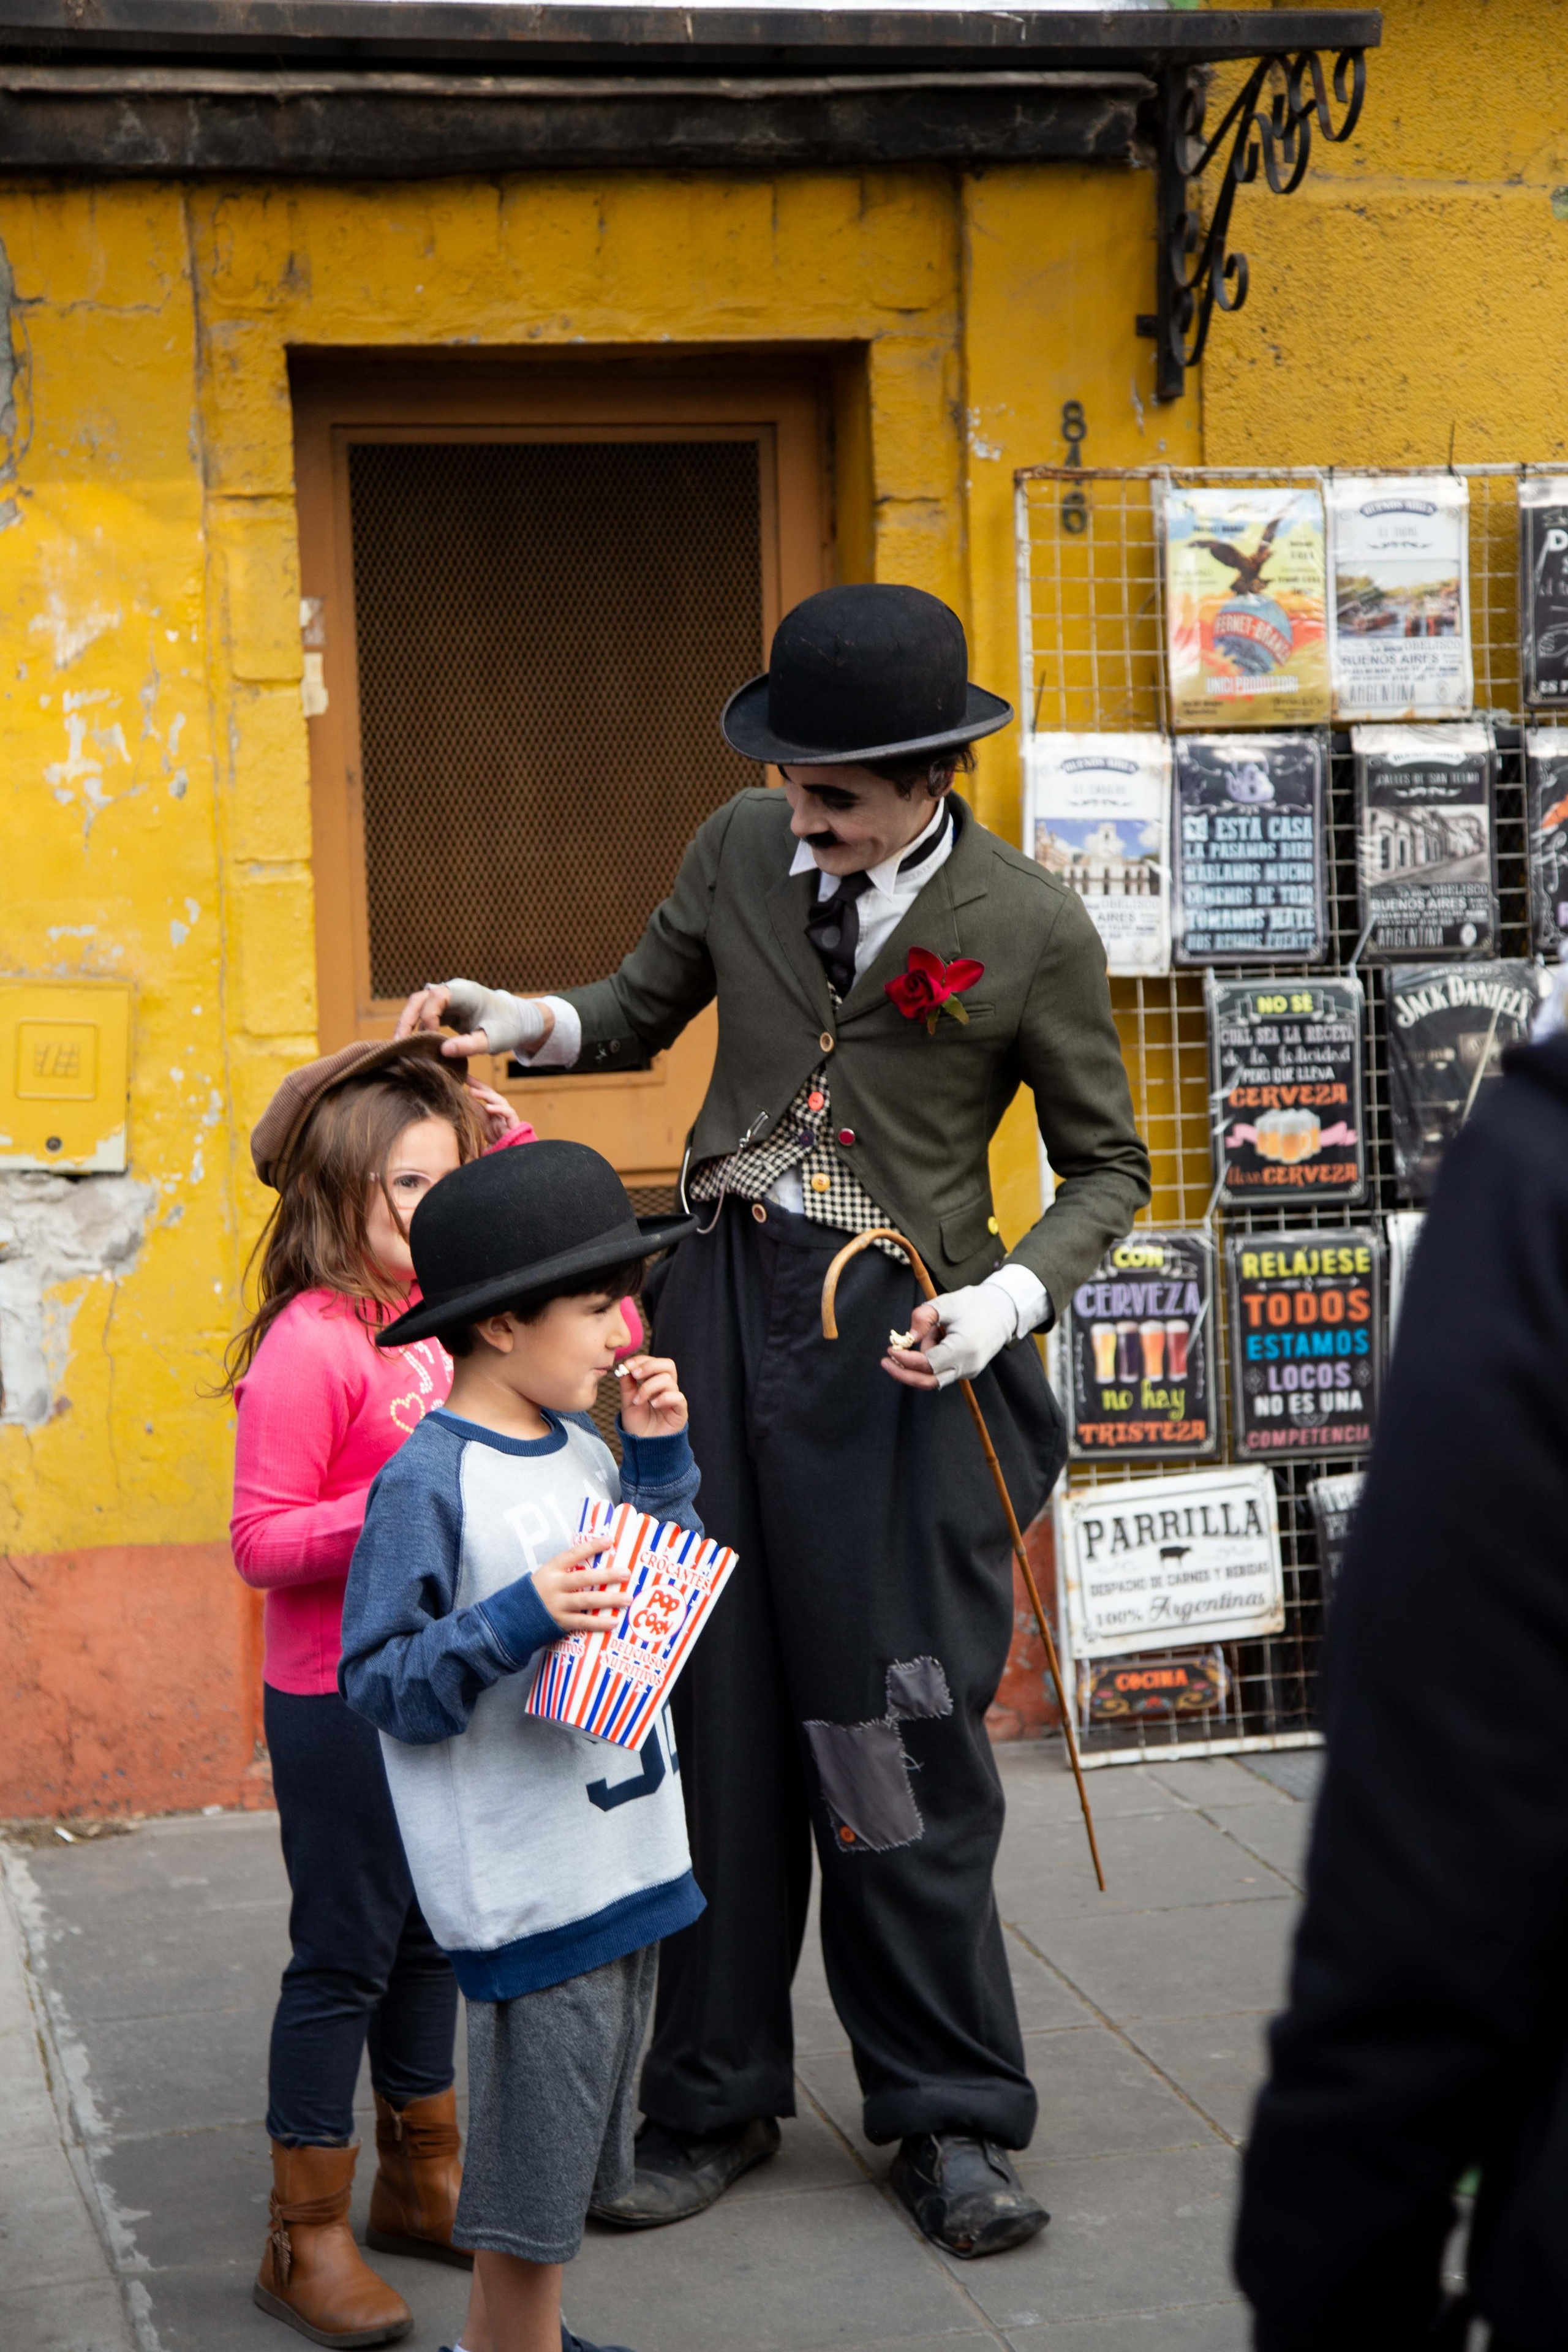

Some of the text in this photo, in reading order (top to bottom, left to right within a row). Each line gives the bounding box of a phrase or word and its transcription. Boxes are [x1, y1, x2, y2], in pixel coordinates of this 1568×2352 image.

[1404, 640, 1461, 651] OBELISCO
[1341, 653, 1396, 666] BUENOS
[1401, 652, 1439, 664] AIRES
[1350, 684, 1416, 703] ARGENTINA
[1214, 816, 1264, 841] ESTA
[1267, 816, 1313, 841] CASA
[1183, 842, 1313, 860] LA PASAMOS BIEN
[1182, 862, 1314, 883] HABLAMOS MUCHO
[1183, 885, 1314, 906] COMEMOS DE TODO
[1431, 884, 1488, 896] OBELISCO
[1098, 911, 1136, 922] AIRES
[1370, 897, 1425, 911] BUENOS
[1426, 897, 1468, 910] AIRES
[1185, 908, 1265, 930] TOMAMOS
[1269, 907, 1316, 929] MATE
[1378, 926, 1444, 948] ARGENTINA
[1257, 995, 1288, 1014] NO
[1393, 984, 1449, 1028] JACK
[1220, 1023, 1355, 1046] CUAL SEA LA RECETA
[1221, 1047, 1241, 1067] de
[1277, 1044, 1351, 1066] felicidad
[1240, 1065, 1336, 1084] PERO QUE LLEVA
[1227, 1082, 1348, 1109] CERVEZA
[1261, 1162, 1358, 1188] CERVEZA
[1113, 1245, 1164, 1269] CON
[1241, 1245, 1371, 1280] RELÁJESE
[1073, 1280, 1201, 1318] CERVEZA
[1241, 1287, 1371, 1328] TODOS
[1246, 1327, 1370, 1362] ESTAMOS
[1267, 1360, 1352, 1393] LOCOS
[1101, 1378, 1186, 1422] no hay
[1253, 1389, 1363, 1418] NO ES UNA
[1077, 1418, 1206, 1448] TRISTEZA
[1082, 1499, 1264, 1559] PARRILLA
[639, 1551, 710, 1591] CROCANTES
[1090, 1561, 1270, 1597] DESPACHO DE CARNES Y BEBIDAS
[646, 1589, 680, 1617] POP
[1095, 1589, 1266, 1627] 100% Argentinas
[633, 1608, 673, 1635] CORN
[610, 1638, 669, 1670] DELICIOSOS
[603, 1654, 663, 1686] NUTRITIVOS
[1114, 1667, 1189, 1692] COCINA
